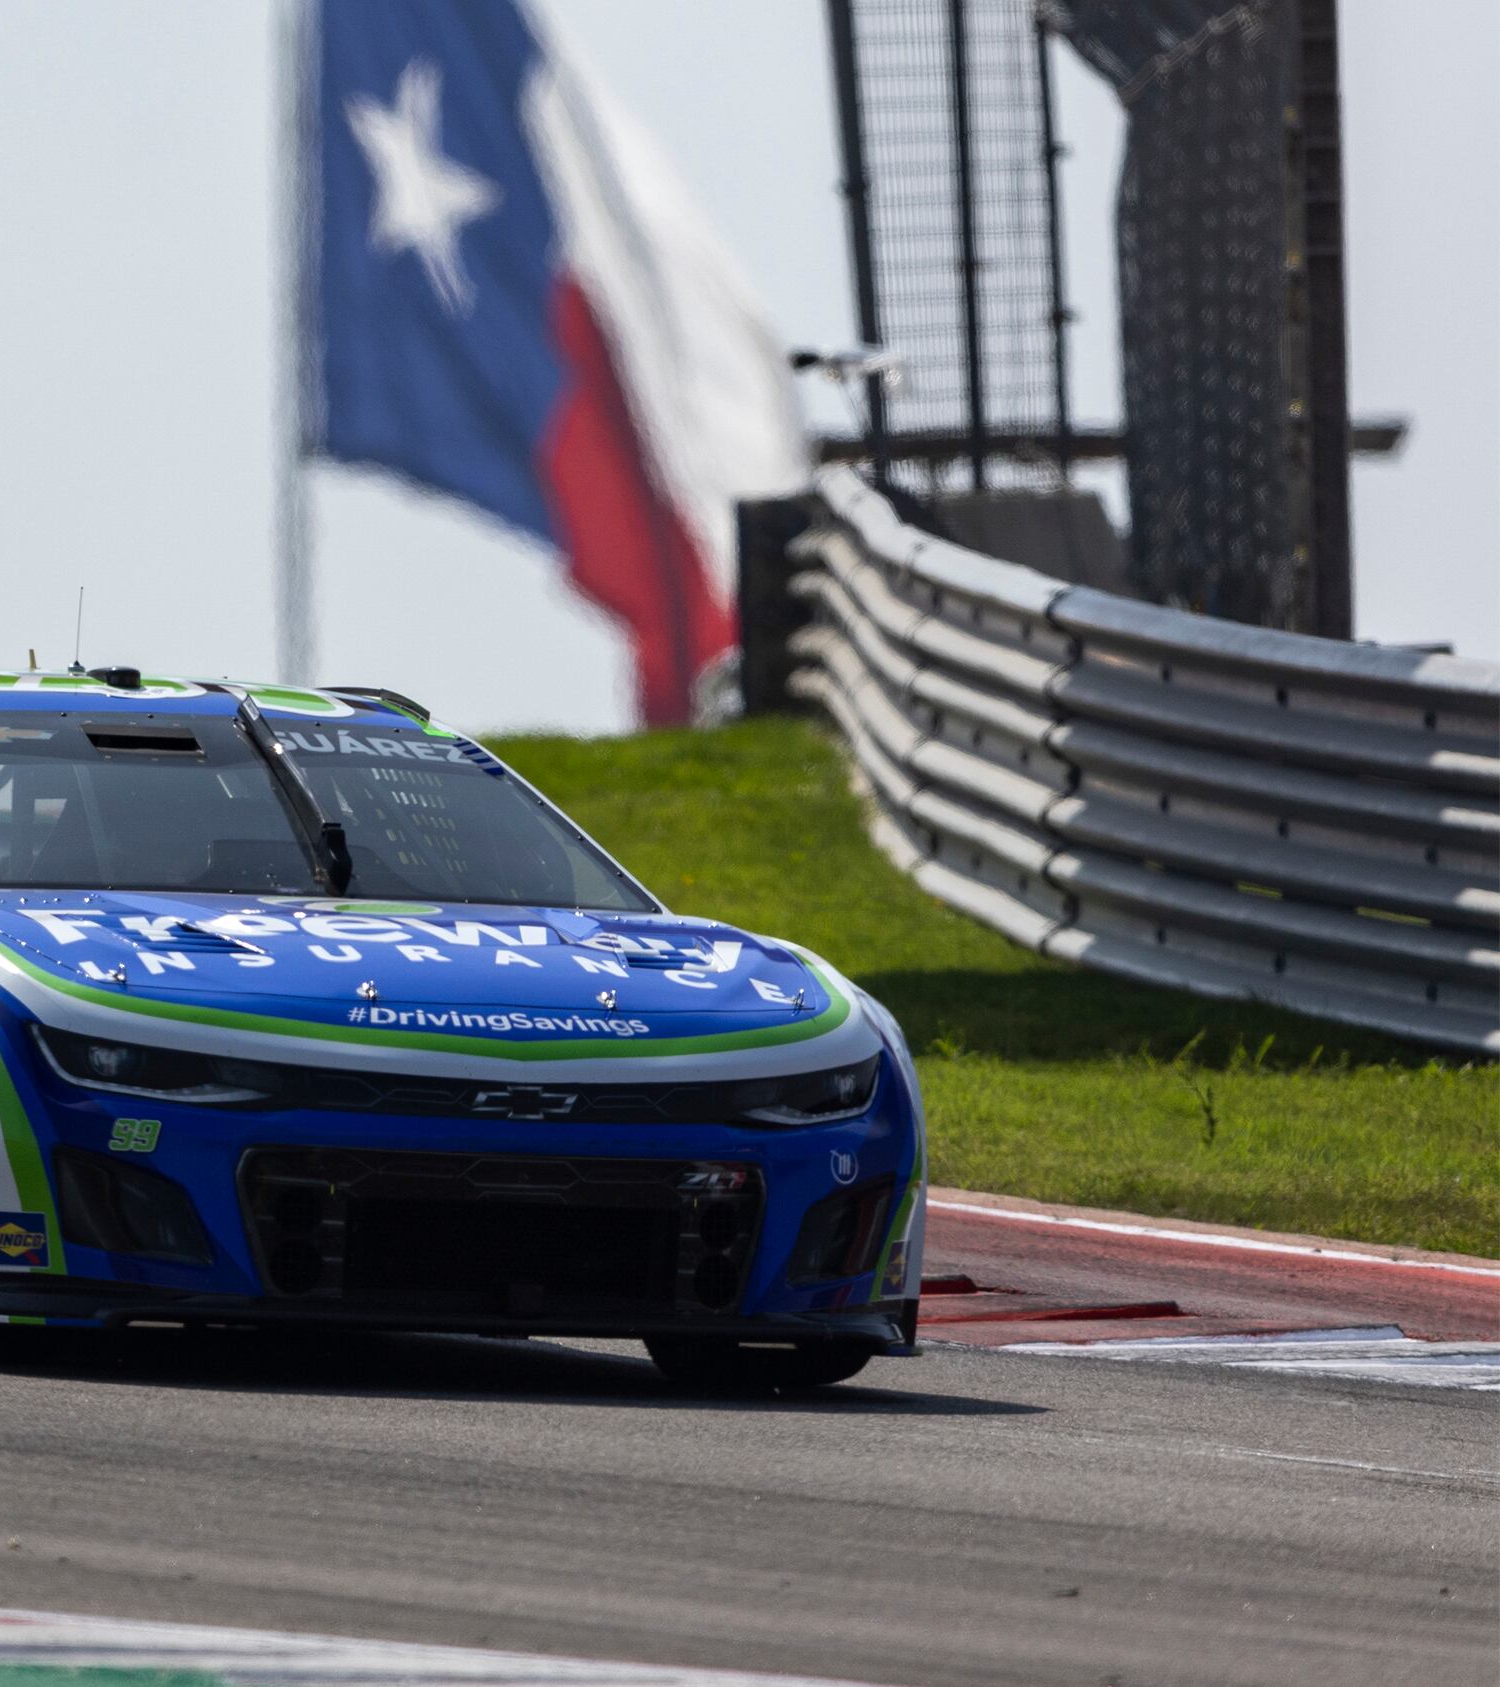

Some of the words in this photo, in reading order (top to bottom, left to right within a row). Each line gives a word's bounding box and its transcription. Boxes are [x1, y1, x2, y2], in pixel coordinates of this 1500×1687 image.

[16, 908, 743, 973] Freeway
[348, 1006, 649, 1038] #DrivingSavings
[108, 1118, 162, 1152] 99
